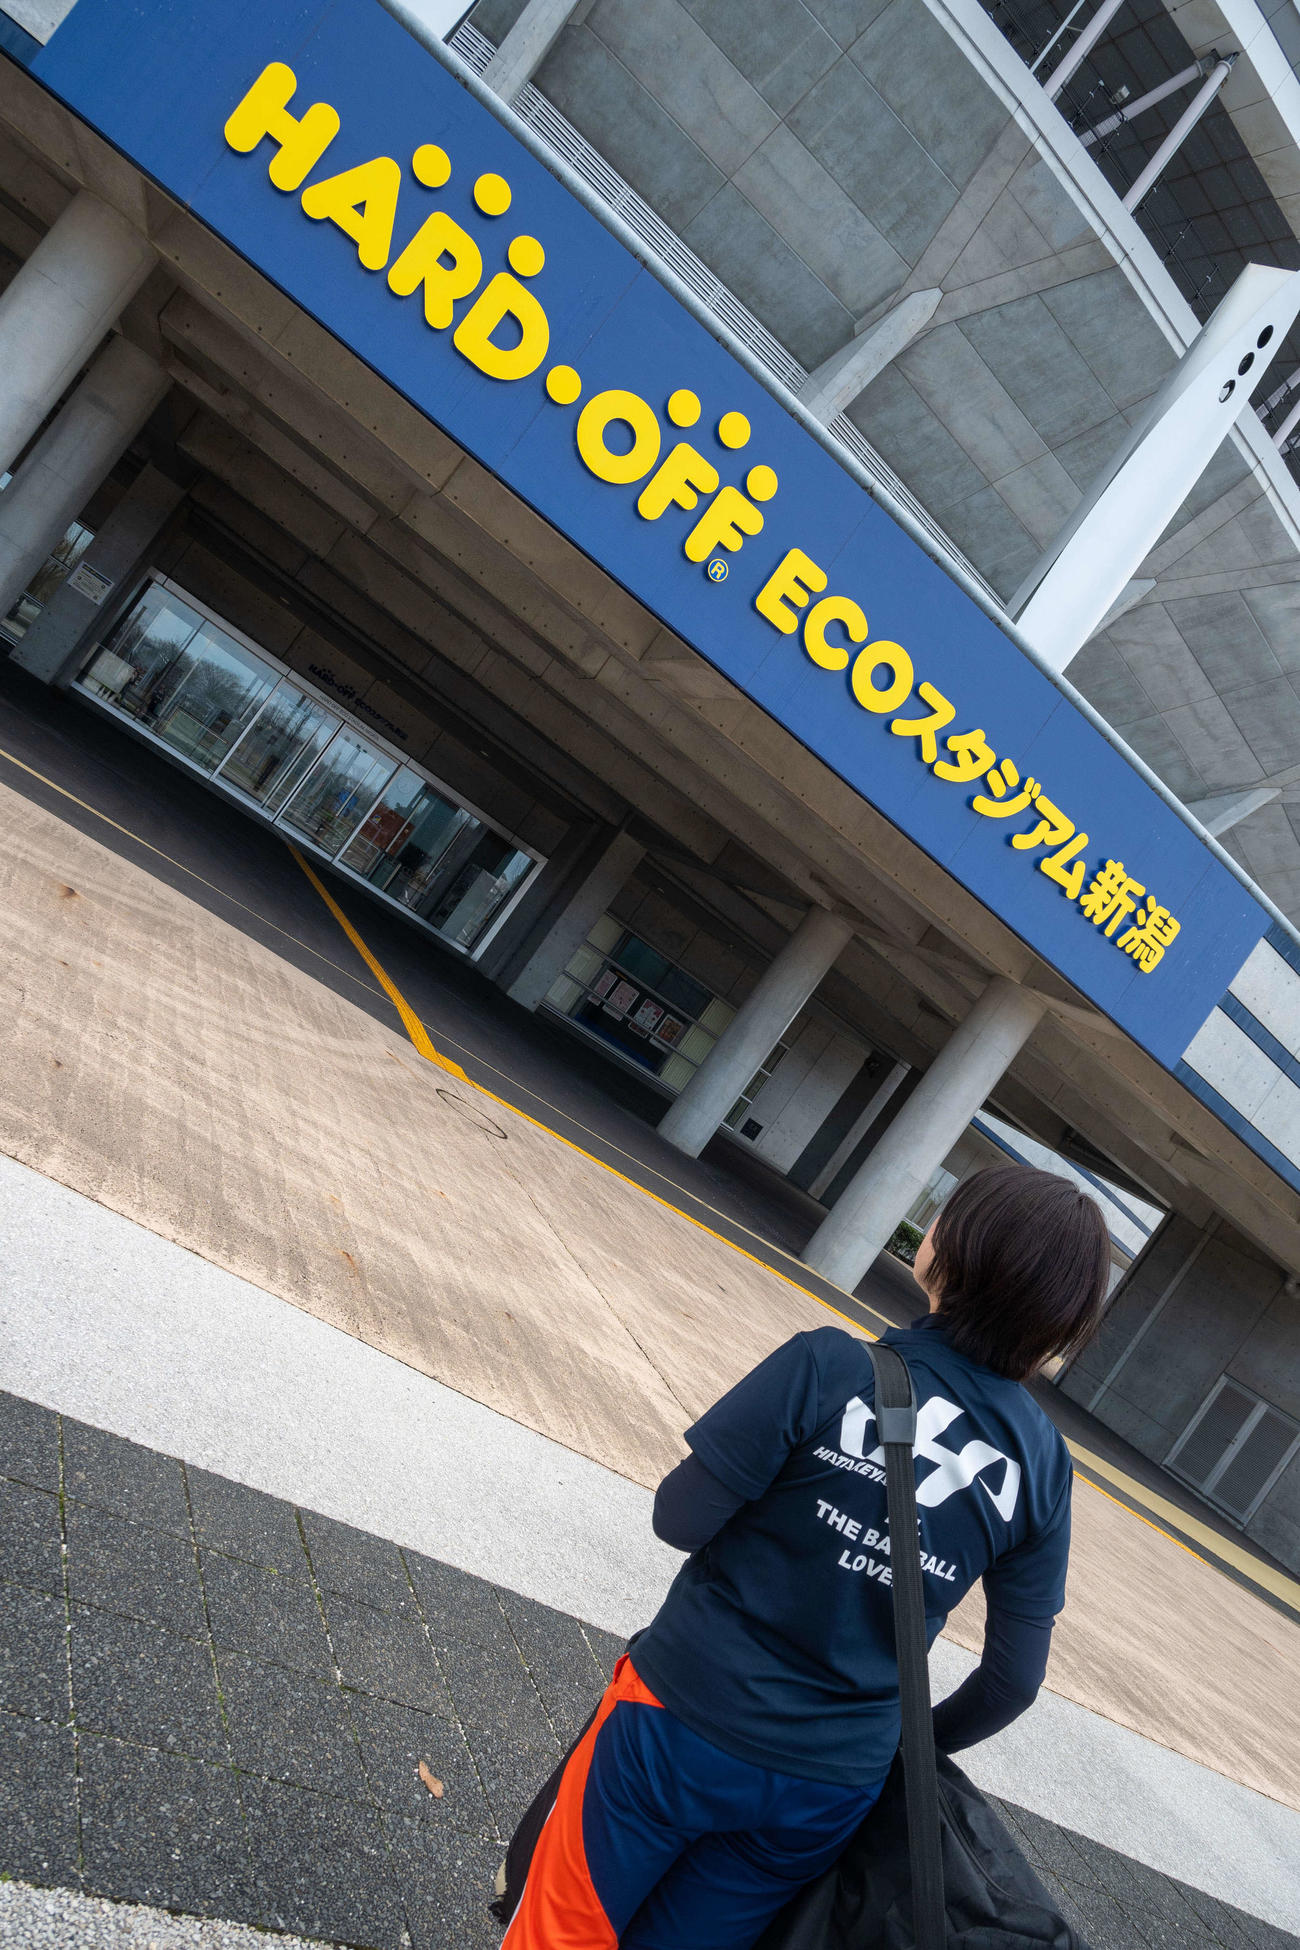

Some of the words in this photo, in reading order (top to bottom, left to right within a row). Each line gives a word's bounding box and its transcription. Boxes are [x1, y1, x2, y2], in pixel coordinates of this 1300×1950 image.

[755, 547, 1181, 975] ECOスタジアム新潟
[812, 1446, 888, 1487] HATAKEYA
[816, 1498, 863, 1541] THE
[837, 1549, 894, 1588] LOVE
